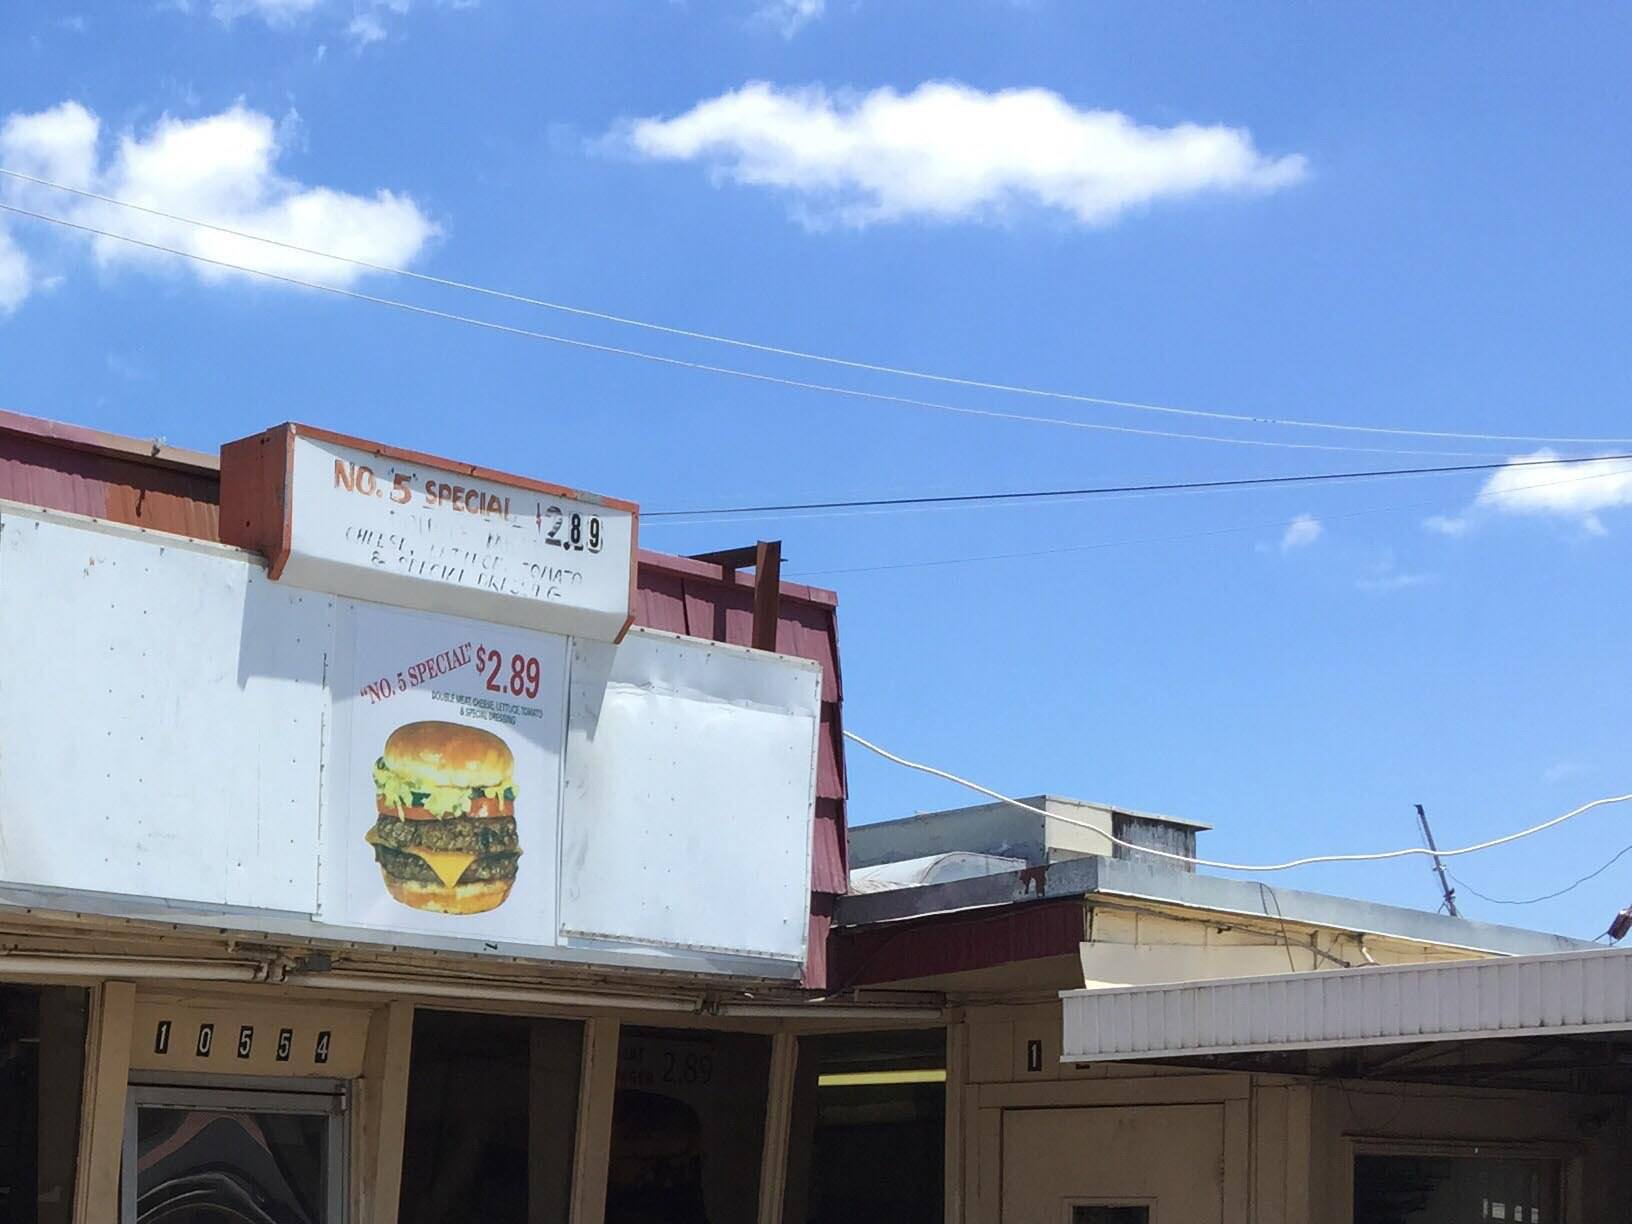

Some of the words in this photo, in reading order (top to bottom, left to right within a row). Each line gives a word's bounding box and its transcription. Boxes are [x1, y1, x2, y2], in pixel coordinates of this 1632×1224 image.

[334, 459, 383, 498] NO.
[425, 479, 511, 521] SPECIAL
[398, 672, 407, 692] 5
[407, 642, 472, 688] SPECIAL"
[475, 643, 541, 699] $2.89
[158, 1023, 330, 1062] 10554
[663, 1047, 713, 1084] 2.89
